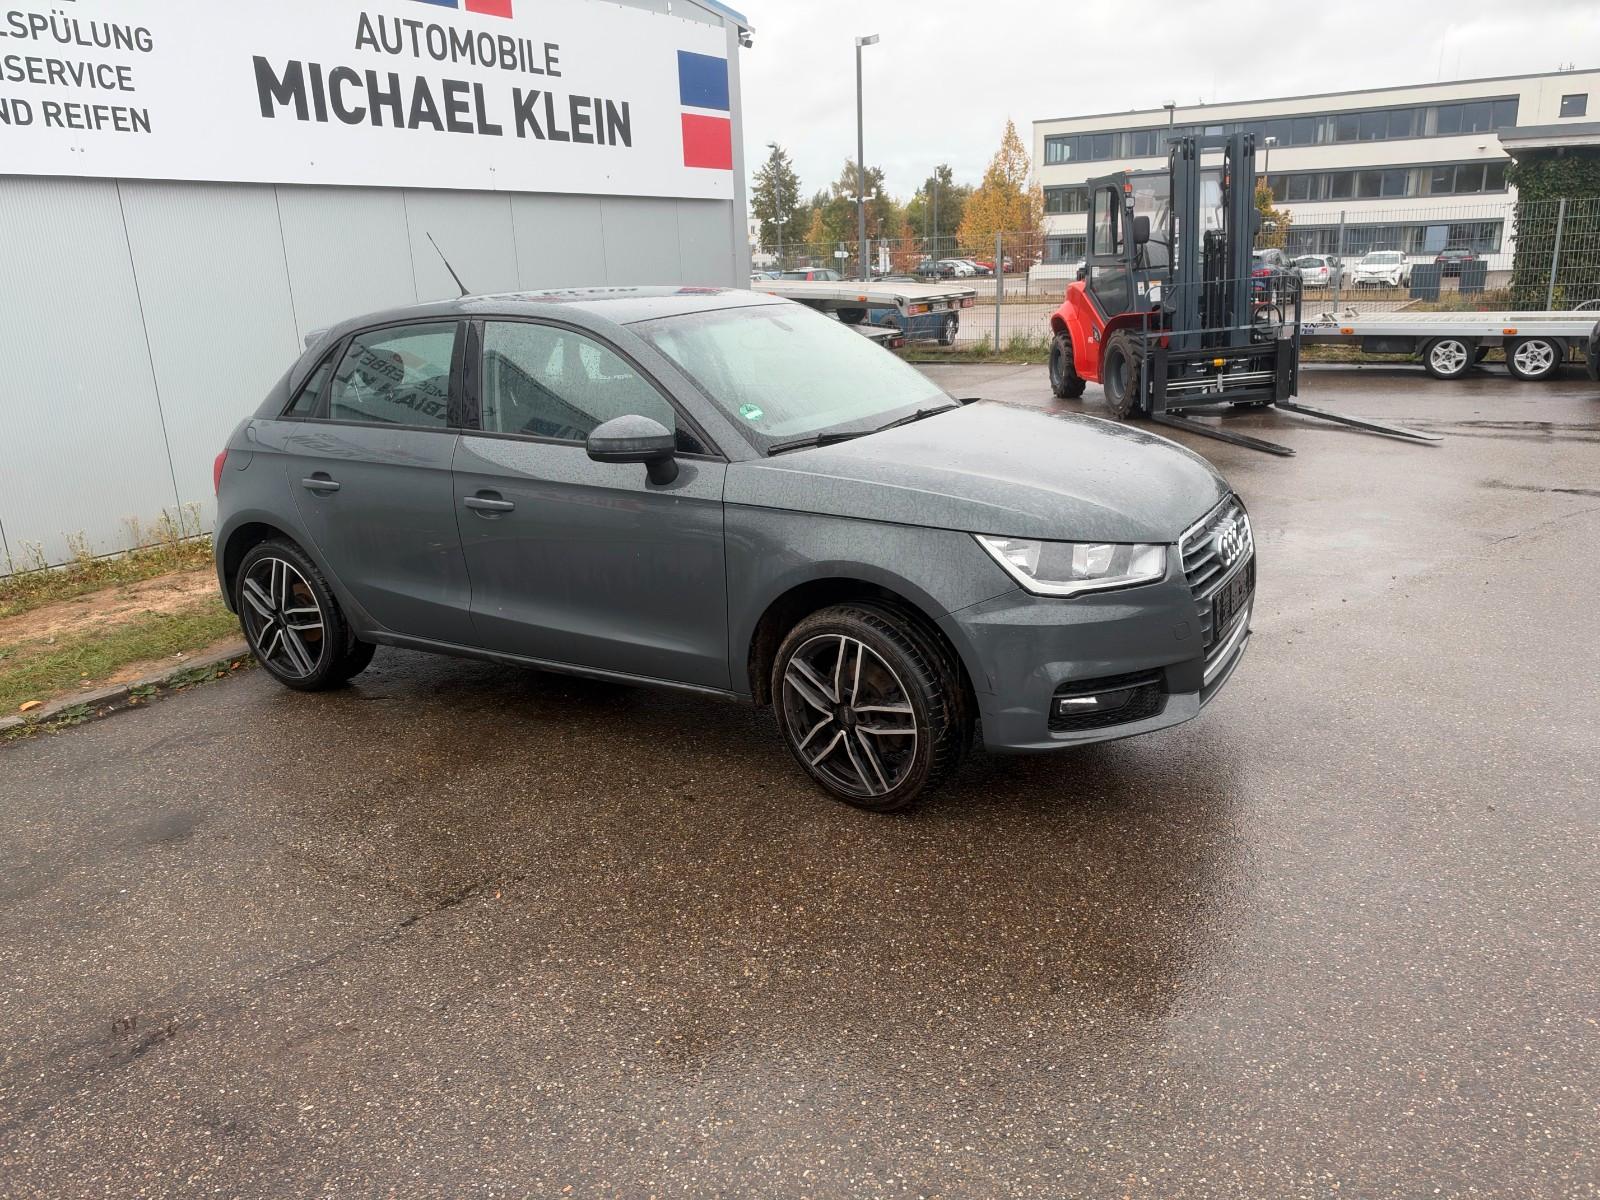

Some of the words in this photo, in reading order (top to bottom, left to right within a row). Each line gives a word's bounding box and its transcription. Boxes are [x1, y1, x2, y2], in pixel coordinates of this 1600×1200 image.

[355, 11, 562, 78] AUTOMOBILE
[0, 54, 136, 92] SERVICE
[41, 100, 152, 134] REIFEN
[252, 55, 503, 137] MICHAEL
[512, 87, 632, 148] KLEIN
